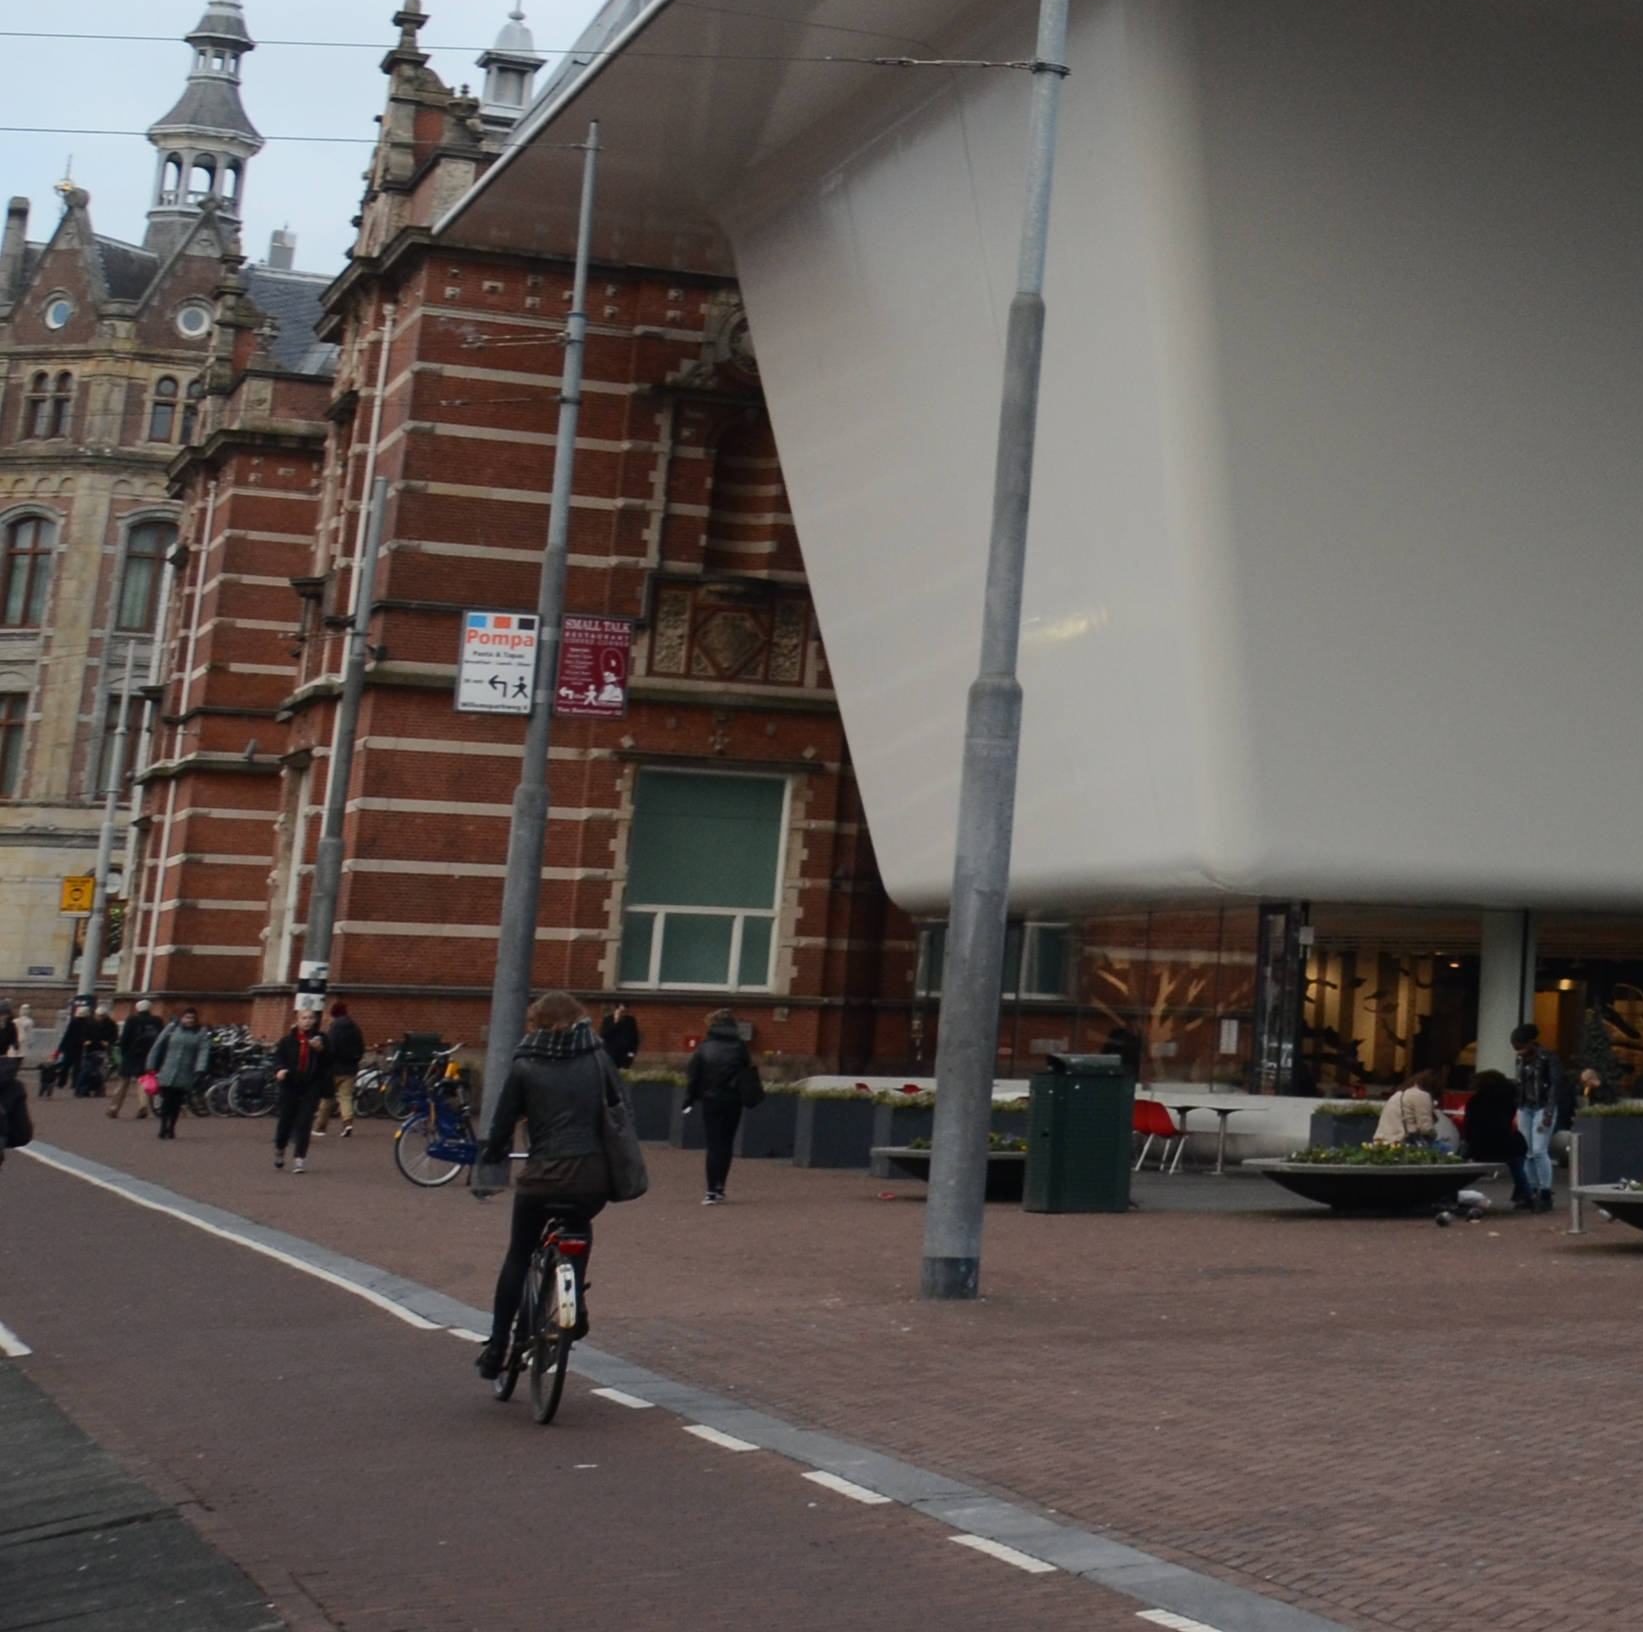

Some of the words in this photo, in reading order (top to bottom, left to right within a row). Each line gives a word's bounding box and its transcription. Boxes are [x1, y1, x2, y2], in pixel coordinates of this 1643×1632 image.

[565, 618, 602, 631] SMALL
[603, 621, 631, 633] TALK
[466, 628, 536, 650] Pompa
